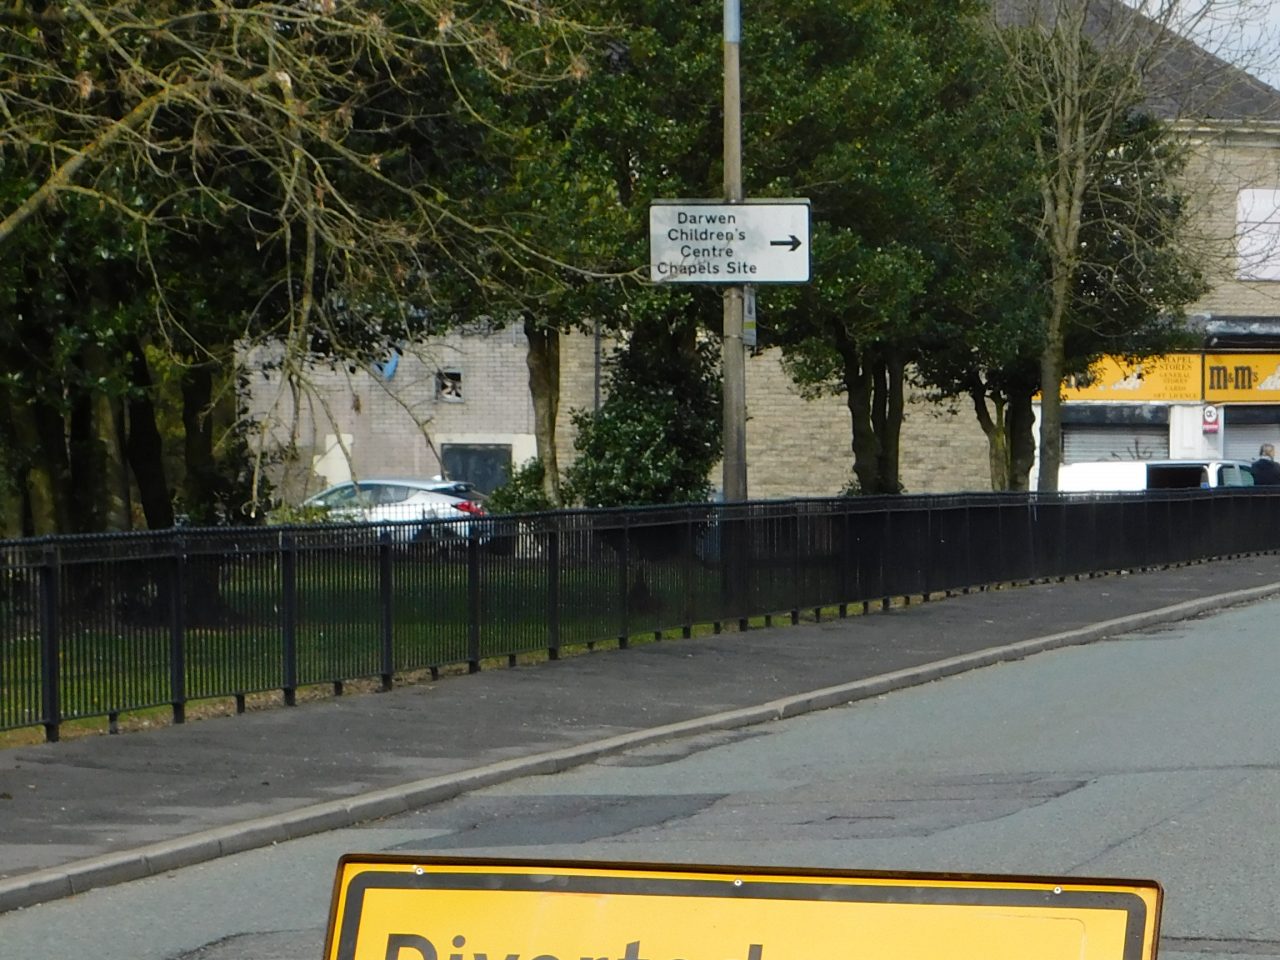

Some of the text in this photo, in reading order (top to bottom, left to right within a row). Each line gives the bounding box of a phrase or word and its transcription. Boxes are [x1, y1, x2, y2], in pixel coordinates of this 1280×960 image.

[677, 211, 736, 225] Darwen
[667, 228, 746, 241] Children's
[680, 245, 734, 258] Centre
[657, 261, 758, 277] Chapels Site
